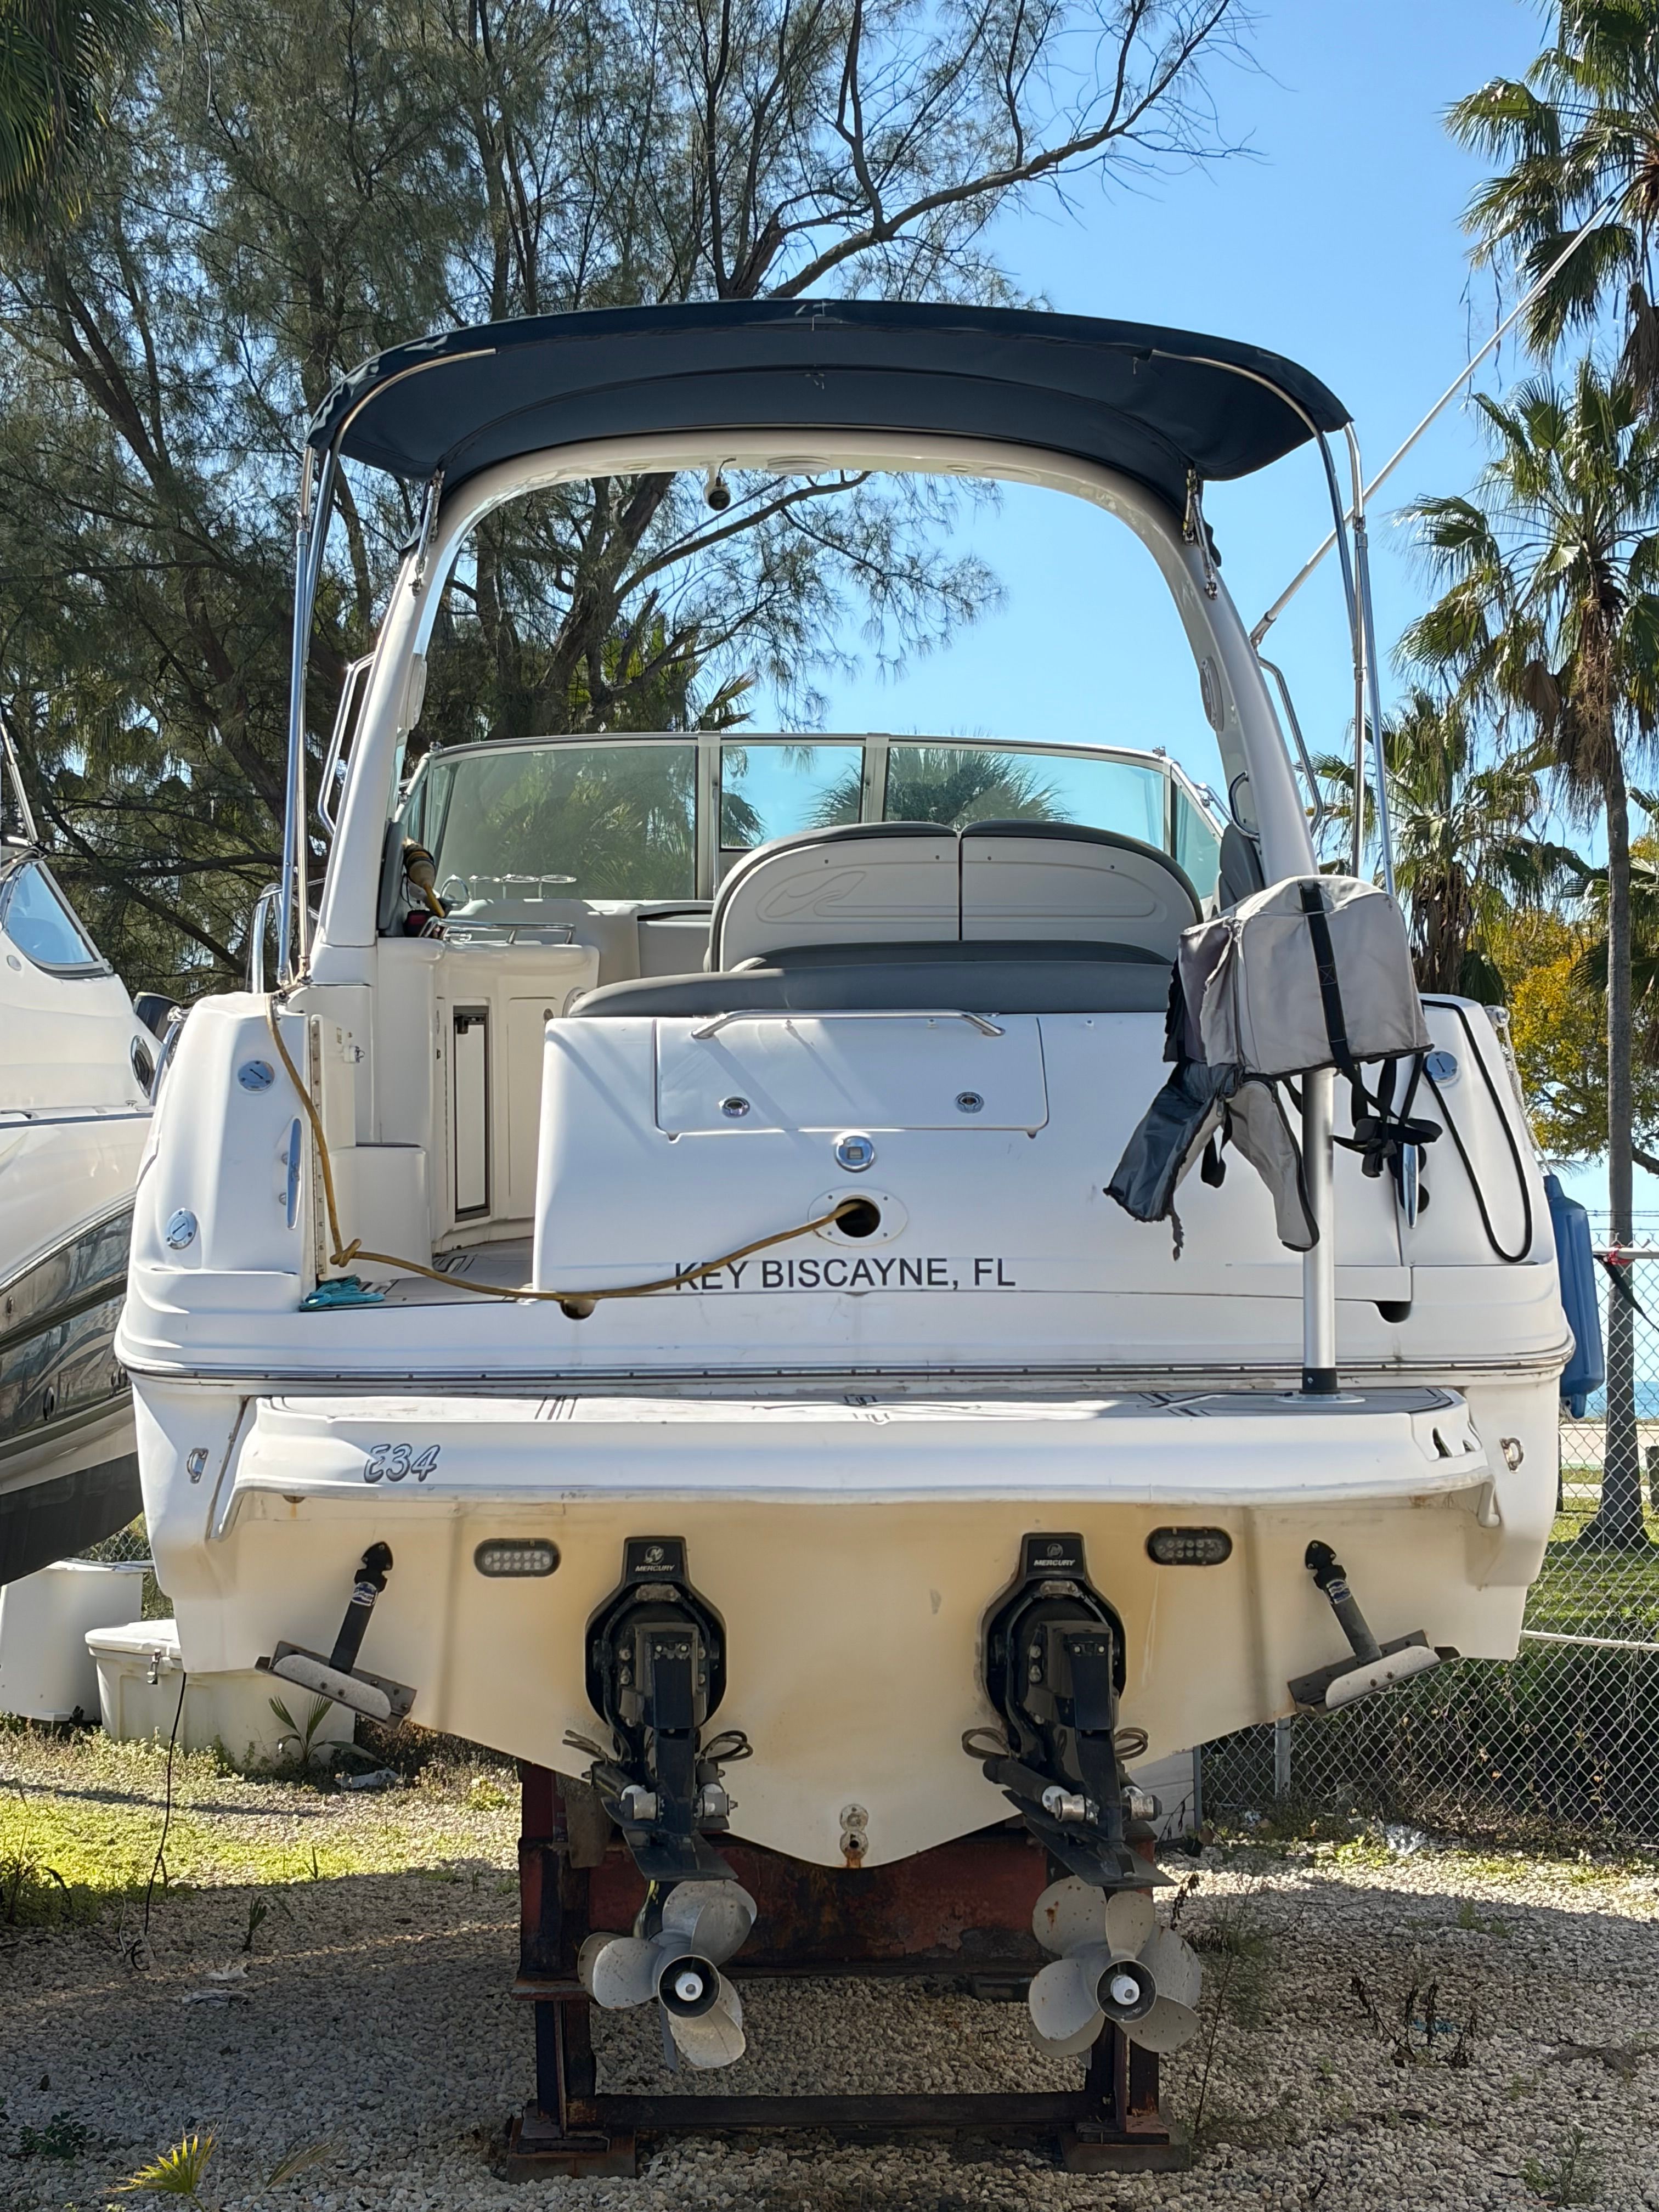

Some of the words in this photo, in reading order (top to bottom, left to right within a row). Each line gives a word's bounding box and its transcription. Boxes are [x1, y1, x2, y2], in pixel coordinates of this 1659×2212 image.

[676, 1261, 749, 1291] KEY
[761, 1258, 958, 1290] BISCAYNE,
[974, 1257, 1016, 1286] FL
[1033, 1559, 1076, 1567] MERCURY
[635, 1564, 675, 1572] MERCURY
